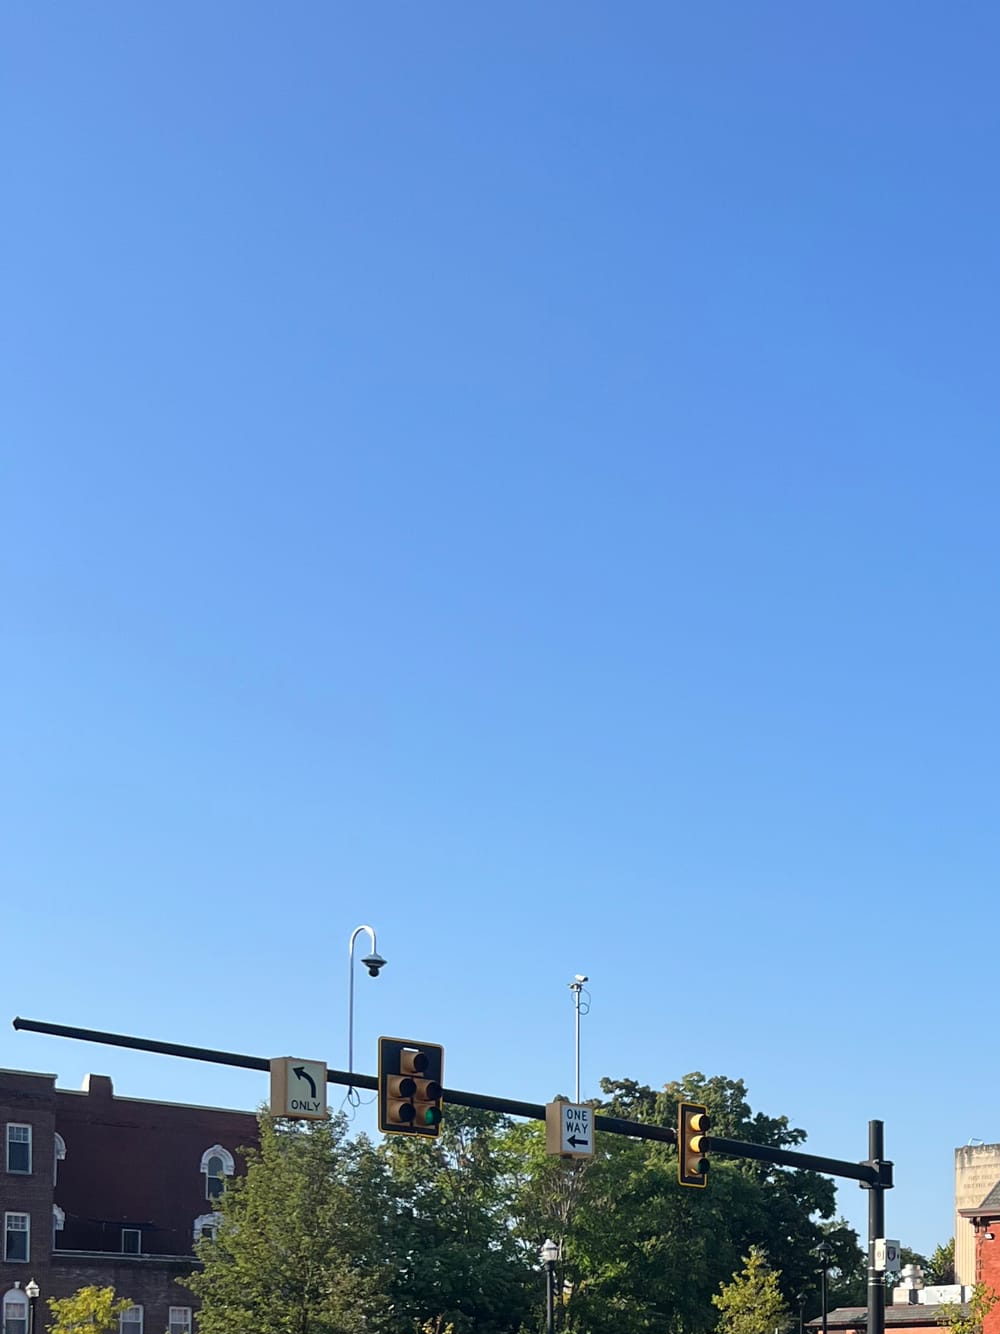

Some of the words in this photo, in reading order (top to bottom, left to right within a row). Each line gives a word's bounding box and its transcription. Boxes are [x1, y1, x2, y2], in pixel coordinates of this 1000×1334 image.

[291, 1099, 320, 1111] ONLY
[567, 1109, 587, 1121] ONE
[566, 1121, 588, 1134] WAY
